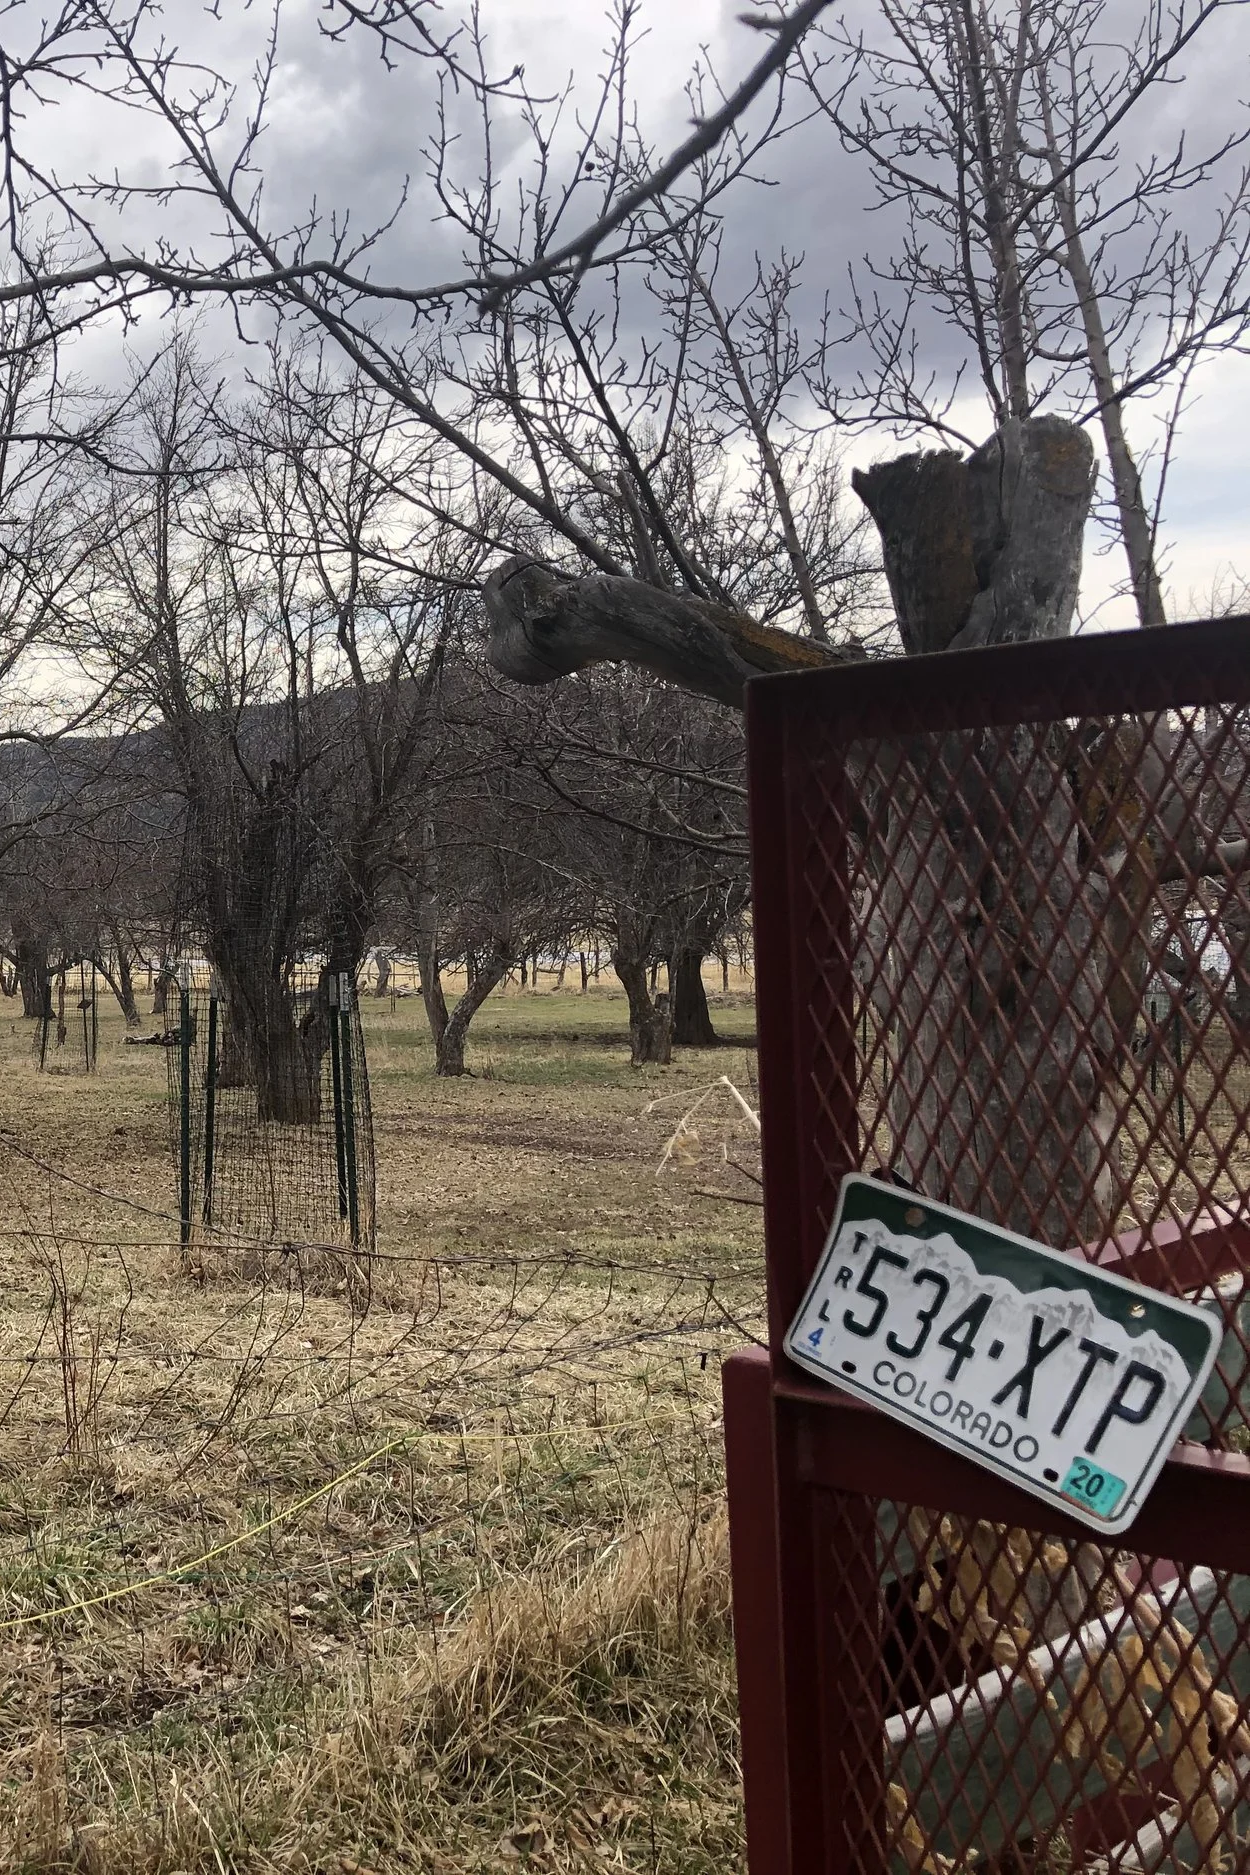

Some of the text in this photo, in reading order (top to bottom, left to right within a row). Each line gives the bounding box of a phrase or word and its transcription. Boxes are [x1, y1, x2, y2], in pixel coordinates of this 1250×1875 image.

[808, 1327, 823, 1347] 4
[872, 1361, 1039, 1462] COLORADO
[1071, 1465, 1104, 1497] 20
